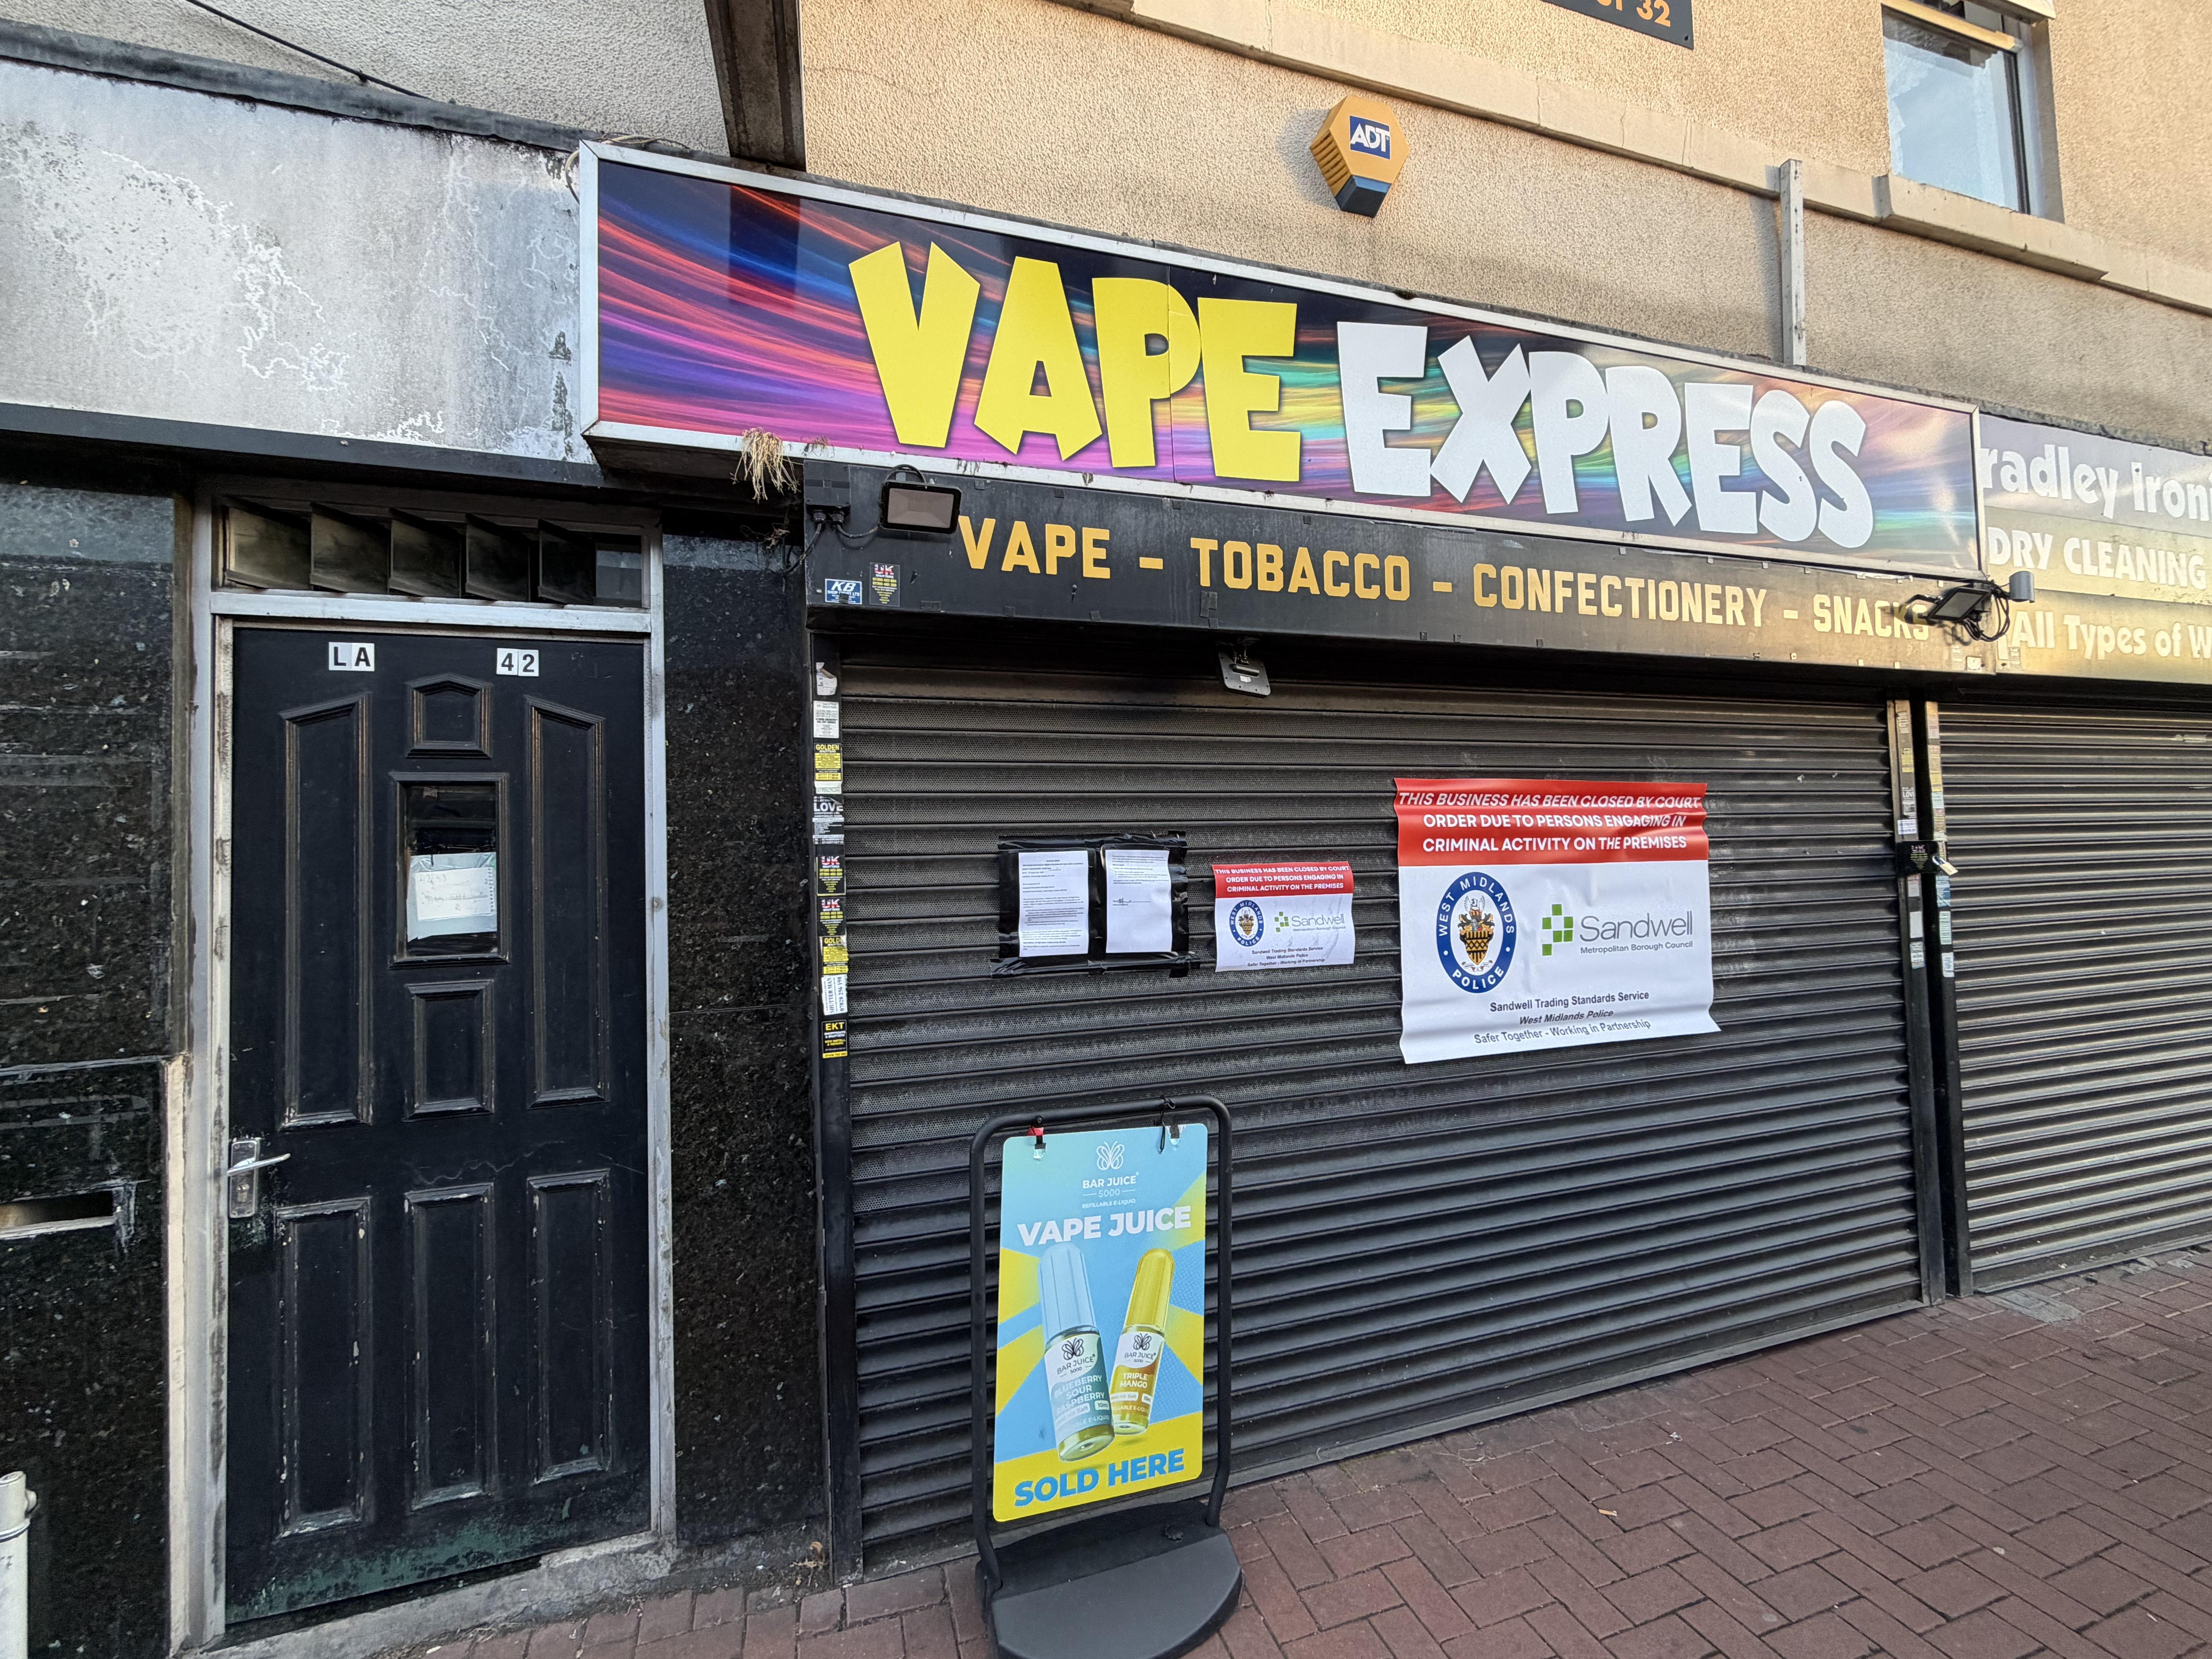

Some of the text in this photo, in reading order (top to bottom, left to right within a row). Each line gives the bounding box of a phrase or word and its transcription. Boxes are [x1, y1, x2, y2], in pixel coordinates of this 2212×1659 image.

[1350, 123, 1391, 152] ADT
[849, 241, 1874, 548] VAPE EXPRESS
[1987, 527, 2207, 590] DRY CLEANING
[874, 564, 894, 575] UK
[958, 515, 1929, 641] VAPE - TOBACCO - CONFECTIONERY - SNACKS
[831, 581, 857, 592] KB
[2011, 611, 2055, 649] All
[2063, 614, 2147, 660] Types
[2155, 622, 2181, 658] of
[333, 646, 371, 667] LA
[501, 653, 535, 672] 42
[814, 802, 844, 812] LOVE
[1399, 792, 1702, 809] THIS BUSINESS HAS BEEN CLOSED BY COURT
[1423, 814, 1687, 828] ORDER DUE TO PERSONS ENGAGING IN
[1422, 836, 1687, 852] CRIMINAL ACTIVITY ON THE PREMISES
[821, 856, 840, 865] UK
[821, 899, 840, 908] UK
[1439, 876, 1515, 937] WEST MIDLANDS
[1240, 902, 1263, 924] MIDLANDS
[1291, 914, 1345, 927] Sandwell
[1580, 910, 1692, 942] Sandwell
[1237, 936, 1260, 945] POLICE
[1580, 940, 1693, 954] Metropolitan Borough Council
[1452, 966, 1504, 989] POLICE
[1490, 991, 1650, 1012] Sandwell Trading Standards Service
[1520, 1010, 1614, 1025] West Midlands Police
[825, 1022, 845, 1030] EKT
[1474, 1034, 1499, 1044] Safer
[1501, 1029, 1543, 1042] Together
[1549, 1025, 1589, 1037] Working
[1590, 1024, 1600, 1033] in
[1601, 1019, 1651, 1032] Partnership
[1083, 1175, 1137, 1189] BAR JUICE
[1098, 1188, 1121, 1198] 5000
[1082, 1200, 1113, 1209] REFILLABLE
[1017, 1206, 1191, 1246] VAPE JUICE
[1137, 1352, 1154, 1360] JUICE
[1057, 1356, 1094, 1375] BAR JUICE
[1123, 1372, 1149, 1381] TRIPLE
[1054, 1374, 1103, 1398] BLUEBERRY
[1066, 1385, 1092, 1400] SOUR
[1120, 1381, 1148, 1389] MANGO
[1056, 1392, 1105, 1413] RASPBERRY
[1014, 1448, 1185, 1507] SOLD HERE
